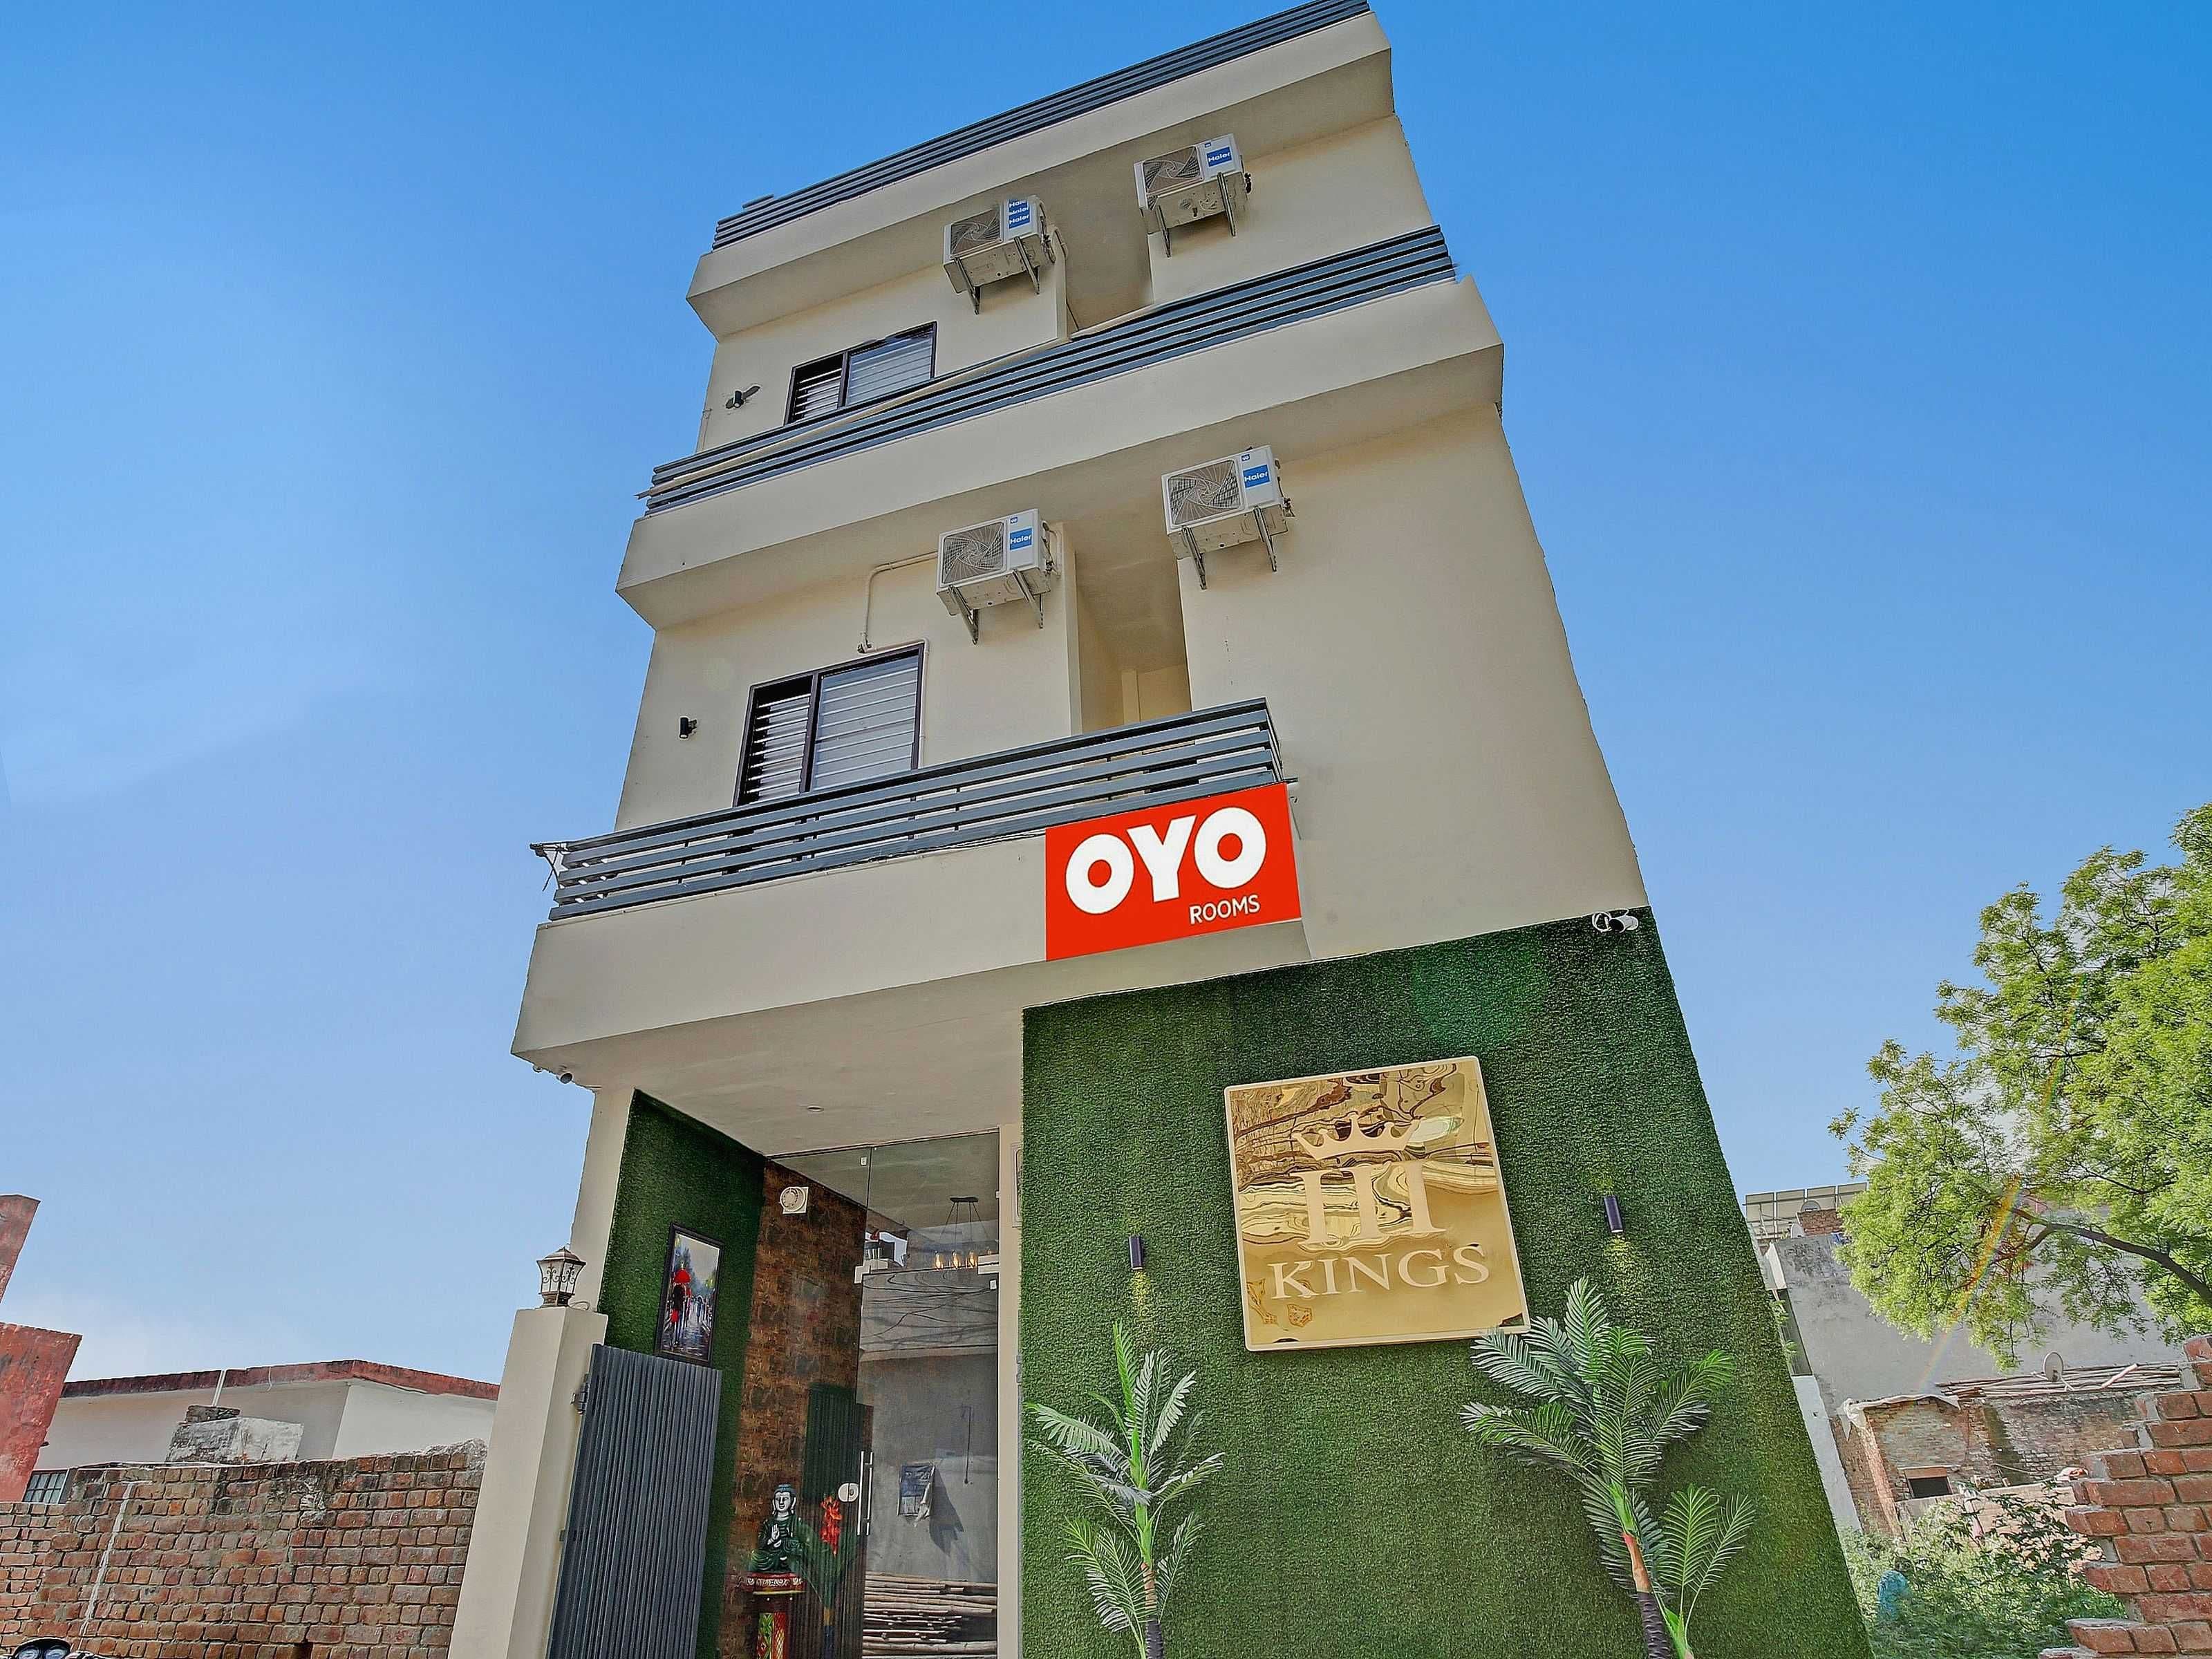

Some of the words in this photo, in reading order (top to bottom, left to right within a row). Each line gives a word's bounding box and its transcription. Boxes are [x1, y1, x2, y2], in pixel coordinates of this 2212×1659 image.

[1244, 471, 1268, 482] Haier
[1010, 535, 1031, 545] Haier
[1065, 807, 1266, 915] OYO
[1189, 894, 1260, 924] ROOMS
[1267, 1245, 1489, 1300] KINGS
